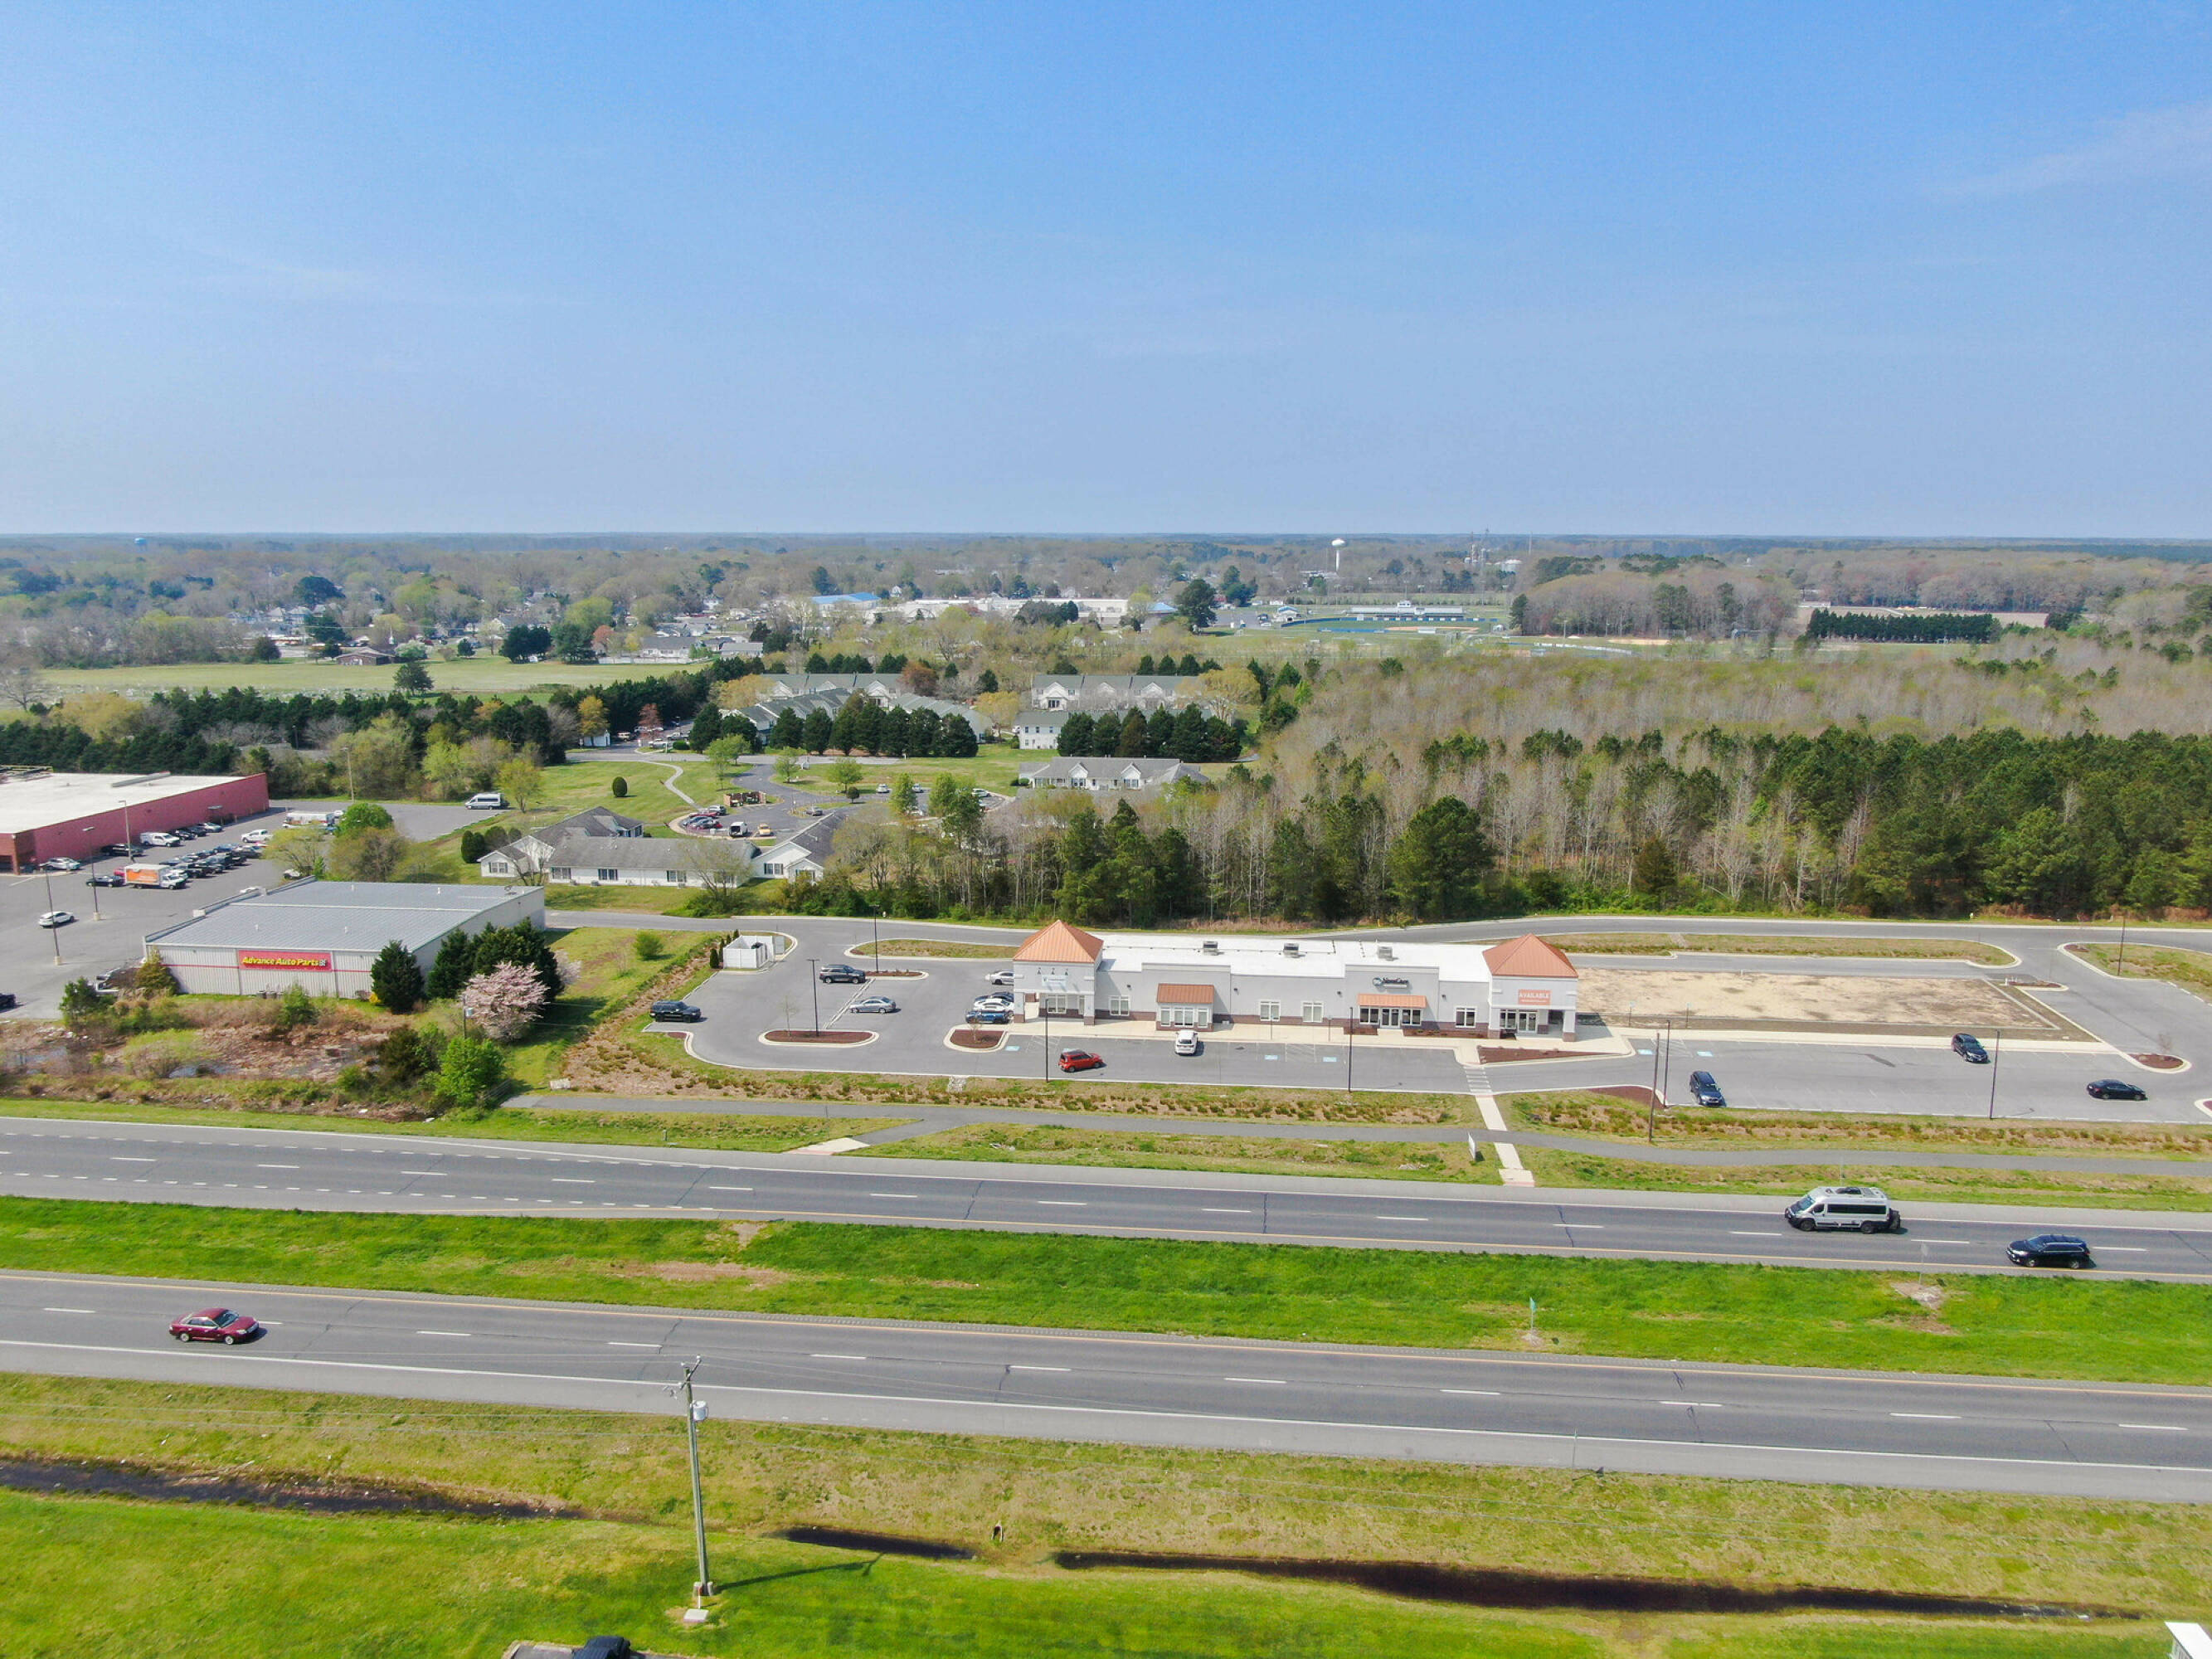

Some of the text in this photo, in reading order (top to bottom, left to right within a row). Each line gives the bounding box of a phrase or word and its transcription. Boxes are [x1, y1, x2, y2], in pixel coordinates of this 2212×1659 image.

[242, 956, 319, 966] Advance Auto Parts
